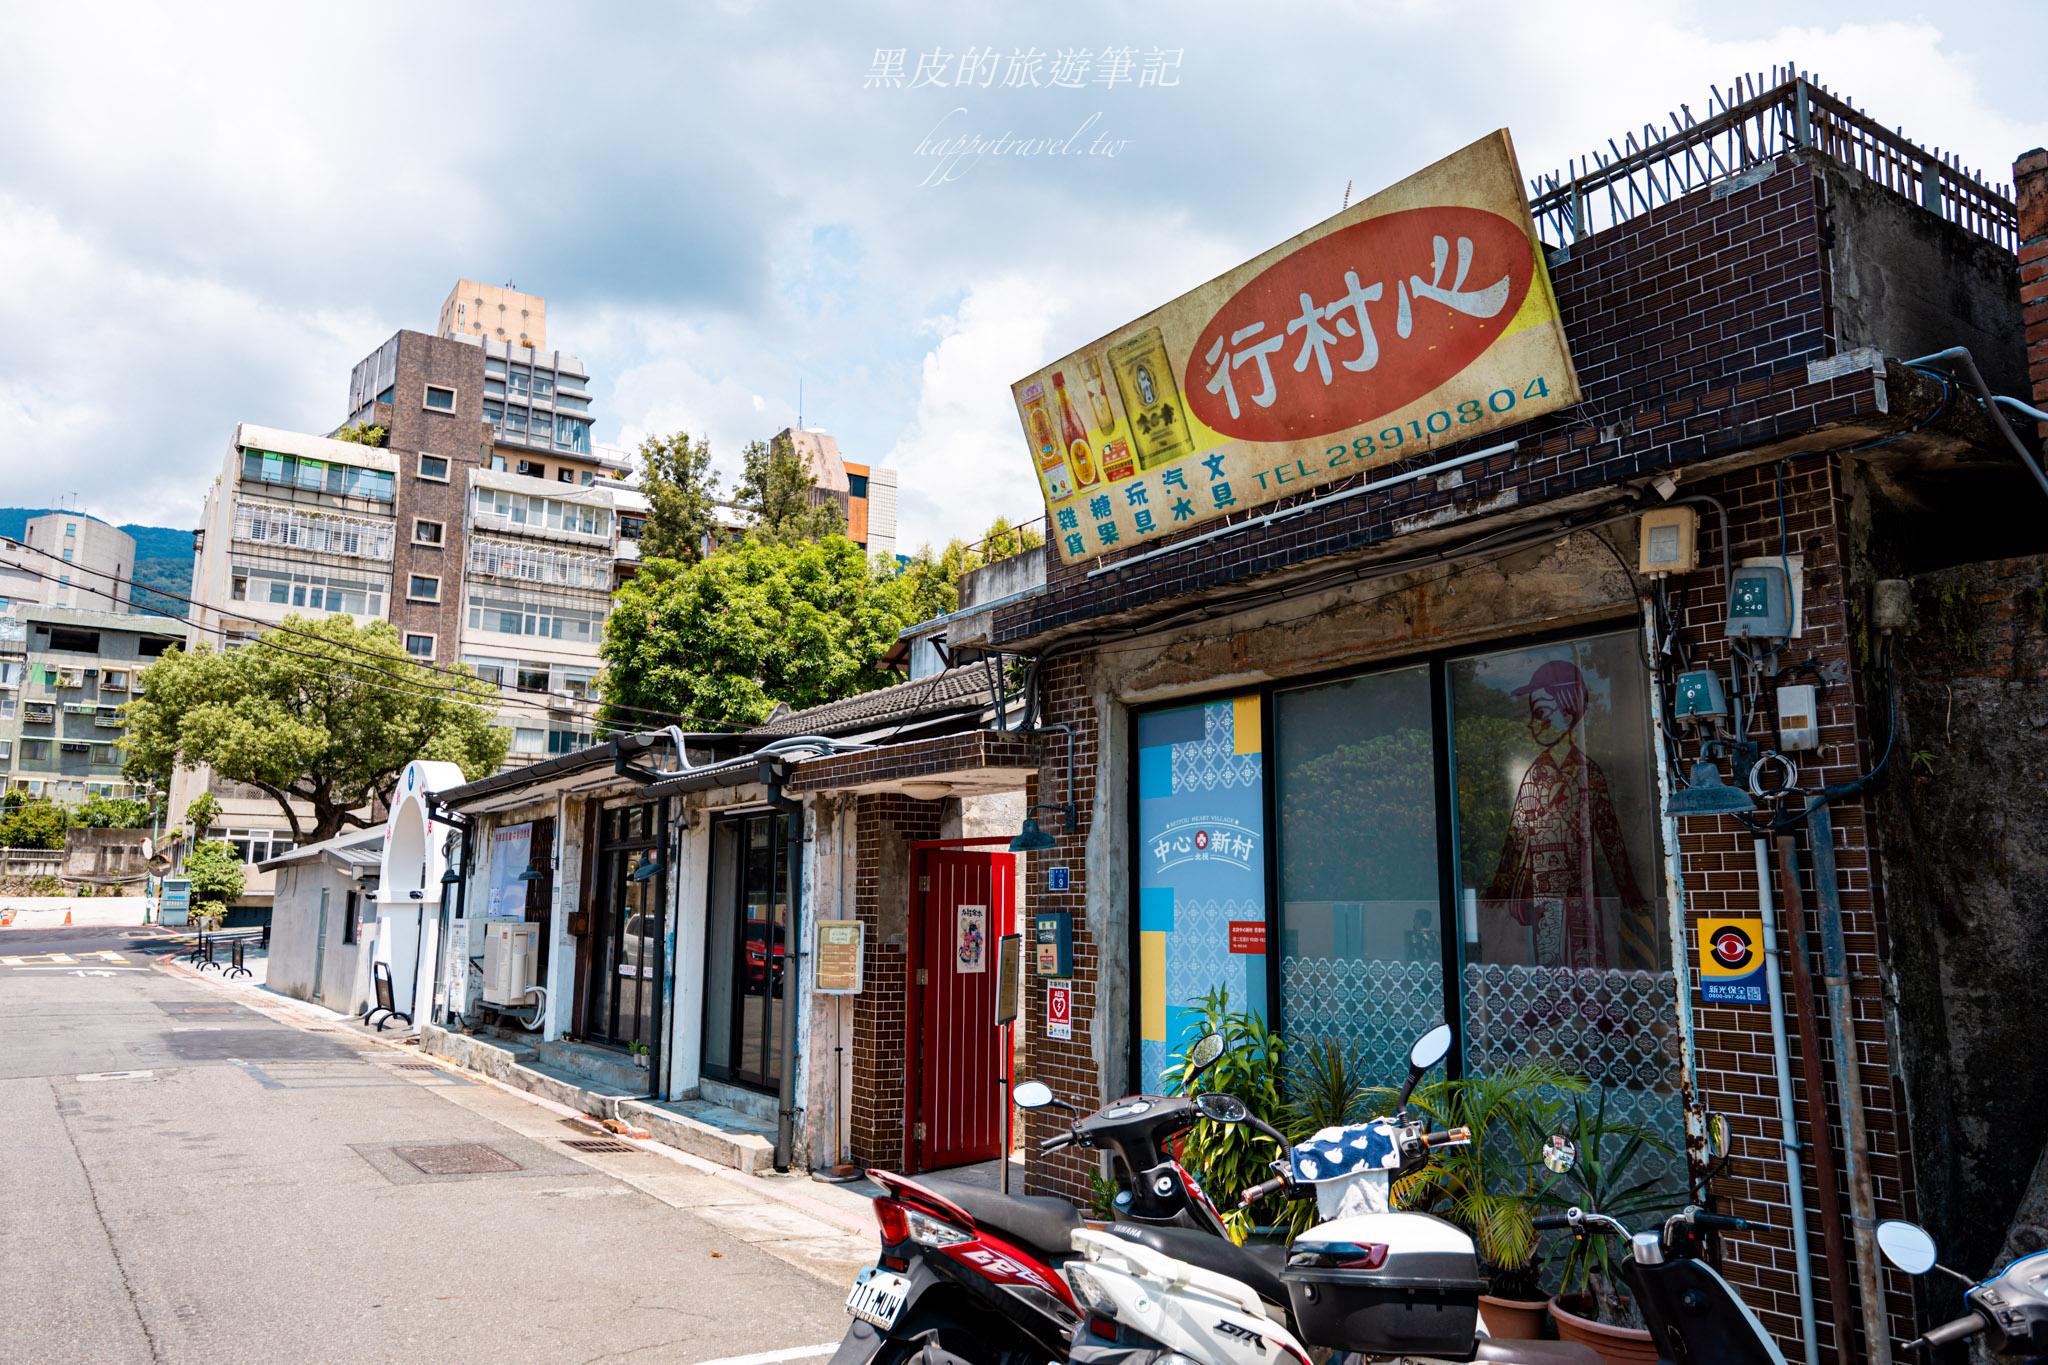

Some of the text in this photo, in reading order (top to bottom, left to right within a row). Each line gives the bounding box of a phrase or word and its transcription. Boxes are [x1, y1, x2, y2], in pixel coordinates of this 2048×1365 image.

[1251, 376, 1550, 491] TEL 28910804
[1058, 878, 1064, 888] 9
[1054, 990, 1065, 998] AED
[1708, 985, 1746, 995] 新光保全
[1113, 1224, 1142, 1239] YAMAHA
[850, 1281, 900, 1320] 711-MUW
[1213, 1319, 1267, 1351] GTR
